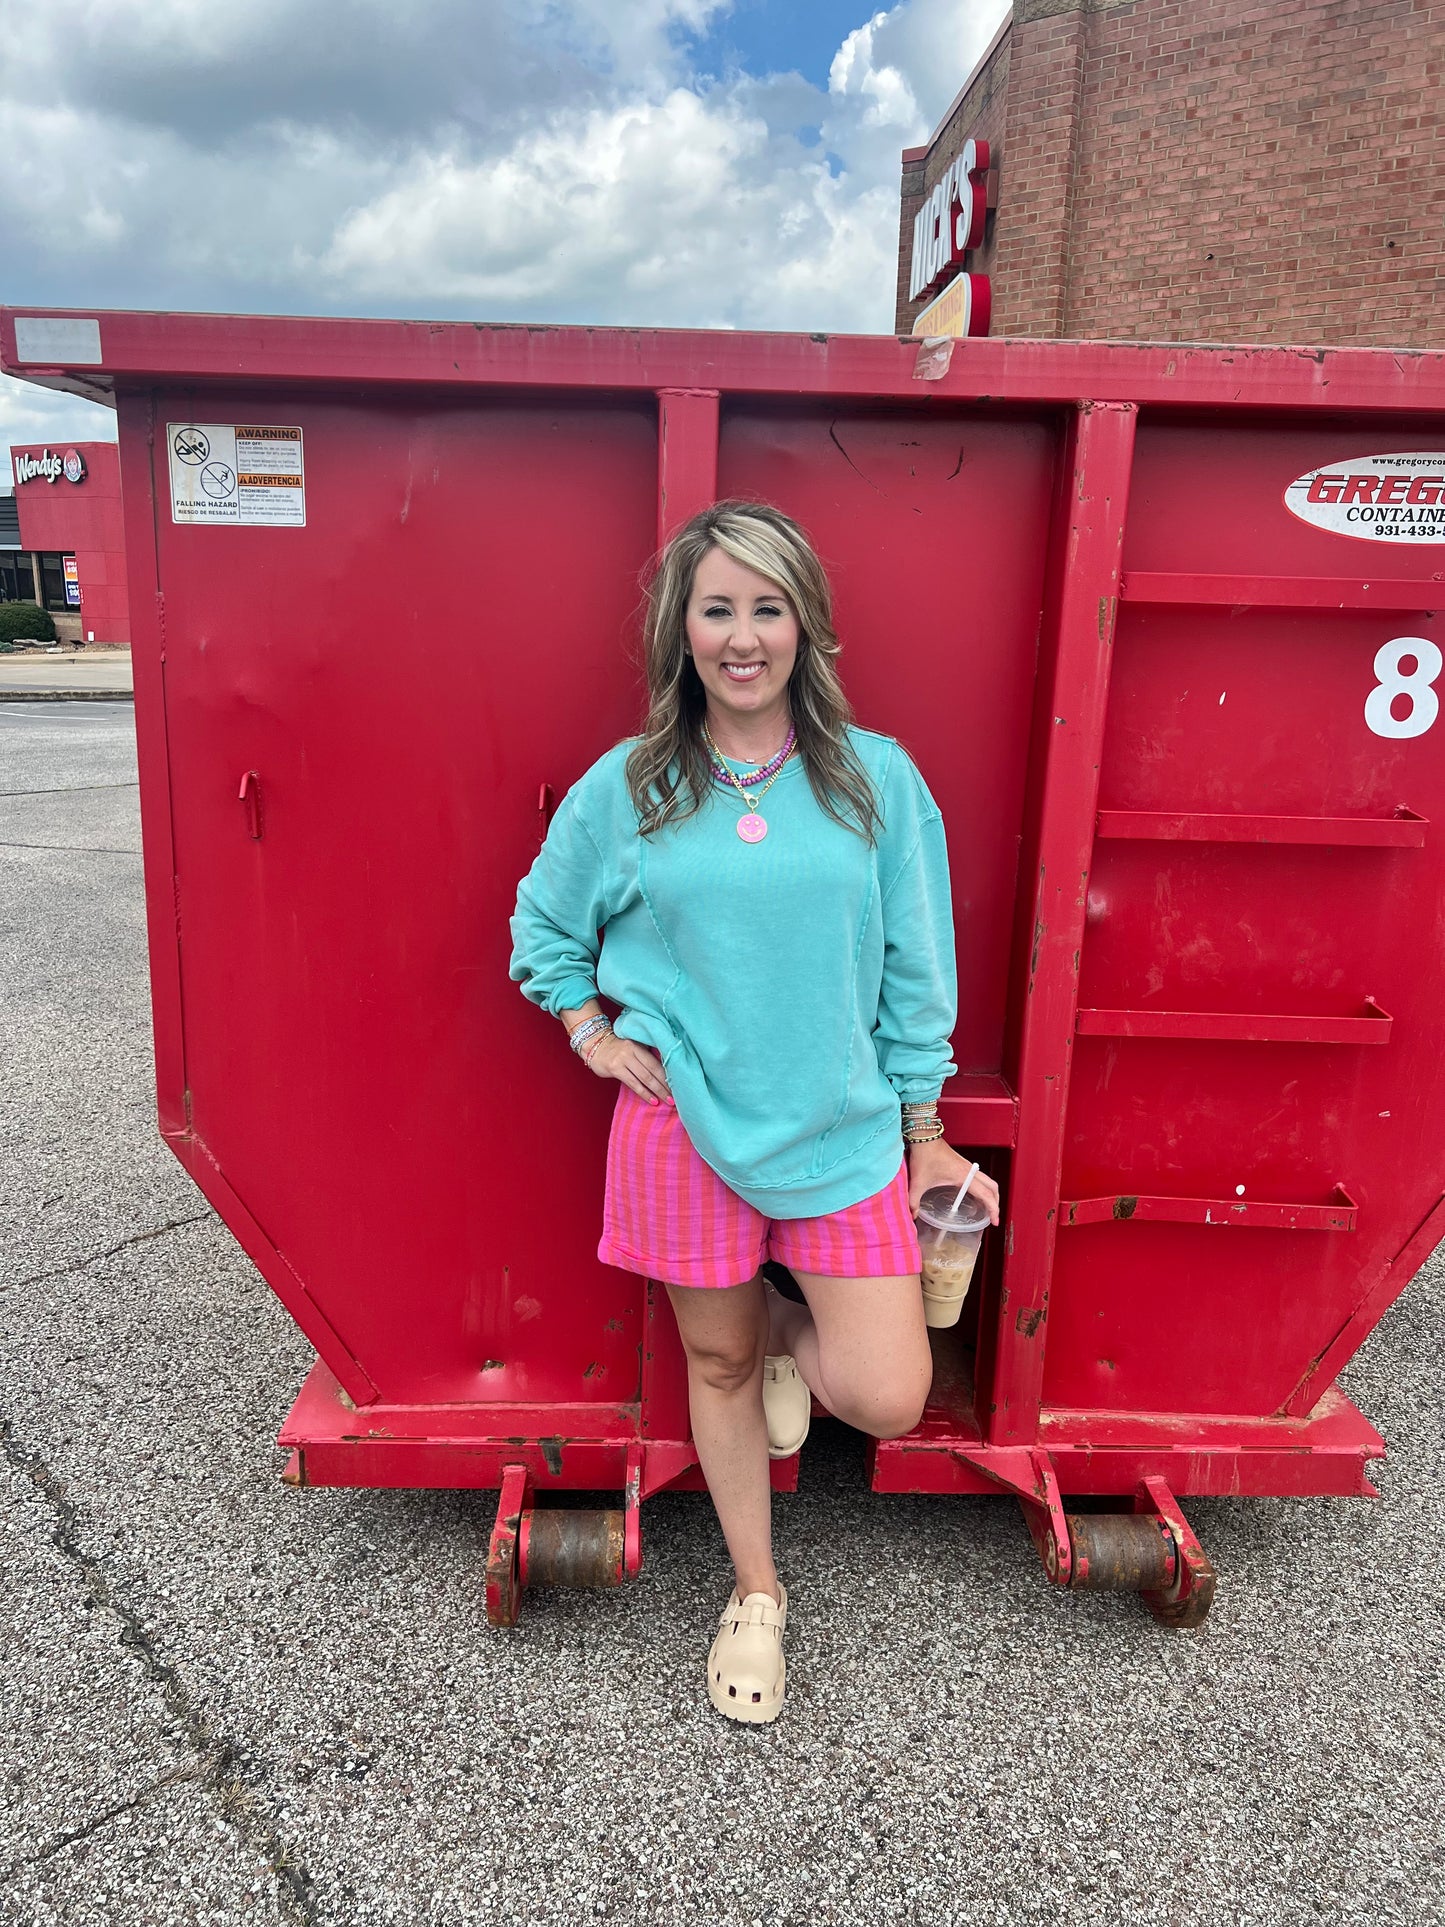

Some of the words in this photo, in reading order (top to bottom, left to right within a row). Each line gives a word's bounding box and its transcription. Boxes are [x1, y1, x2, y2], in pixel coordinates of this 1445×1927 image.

[245, 429, 297, 438] WARNING
[15, 448, 61, 484] Wendy's
[248, 476, 300, 486] ADVERTENCIA
[1307, 475, 1445, 504] GREG
[1364, 636, 1443, 739] 8
